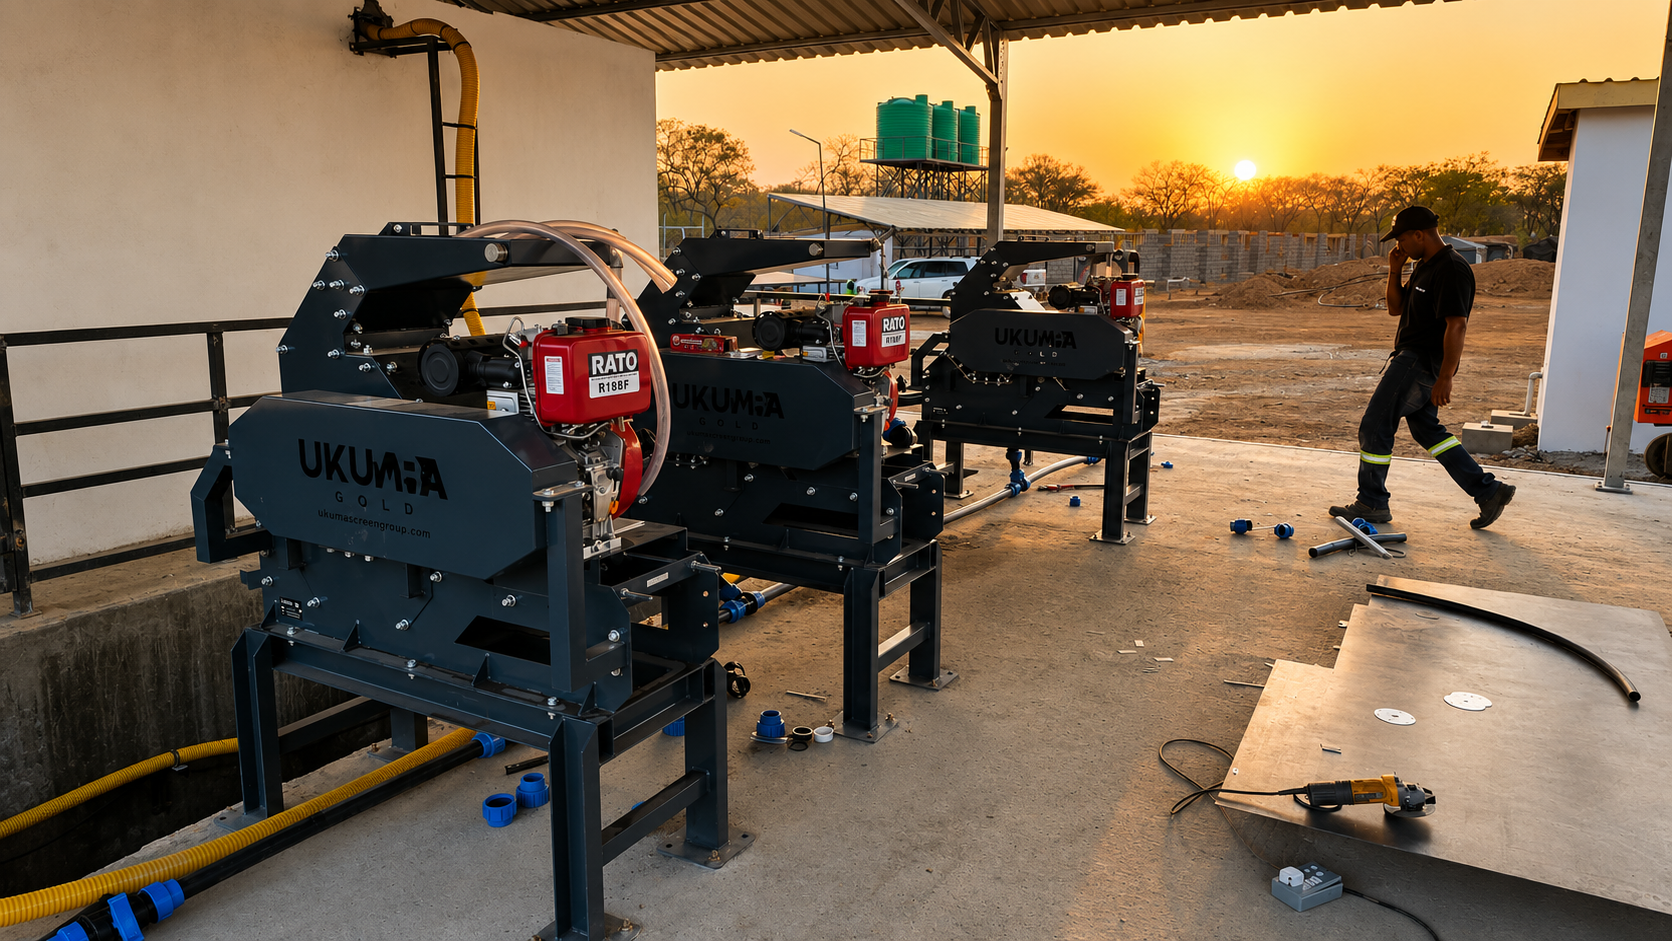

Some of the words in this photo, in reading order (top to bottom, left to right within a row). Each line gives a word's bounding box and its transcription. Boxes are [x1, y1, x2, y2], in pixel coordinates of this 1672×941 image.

[883, 316, 905, 332] RATO
[591, 351, 638, 375] RATO
[699, 417, 758, 430] GOLD
[335, 491, 413, 515] GOLD
[318, 509, 431, 538] ukumascreengroup.com
